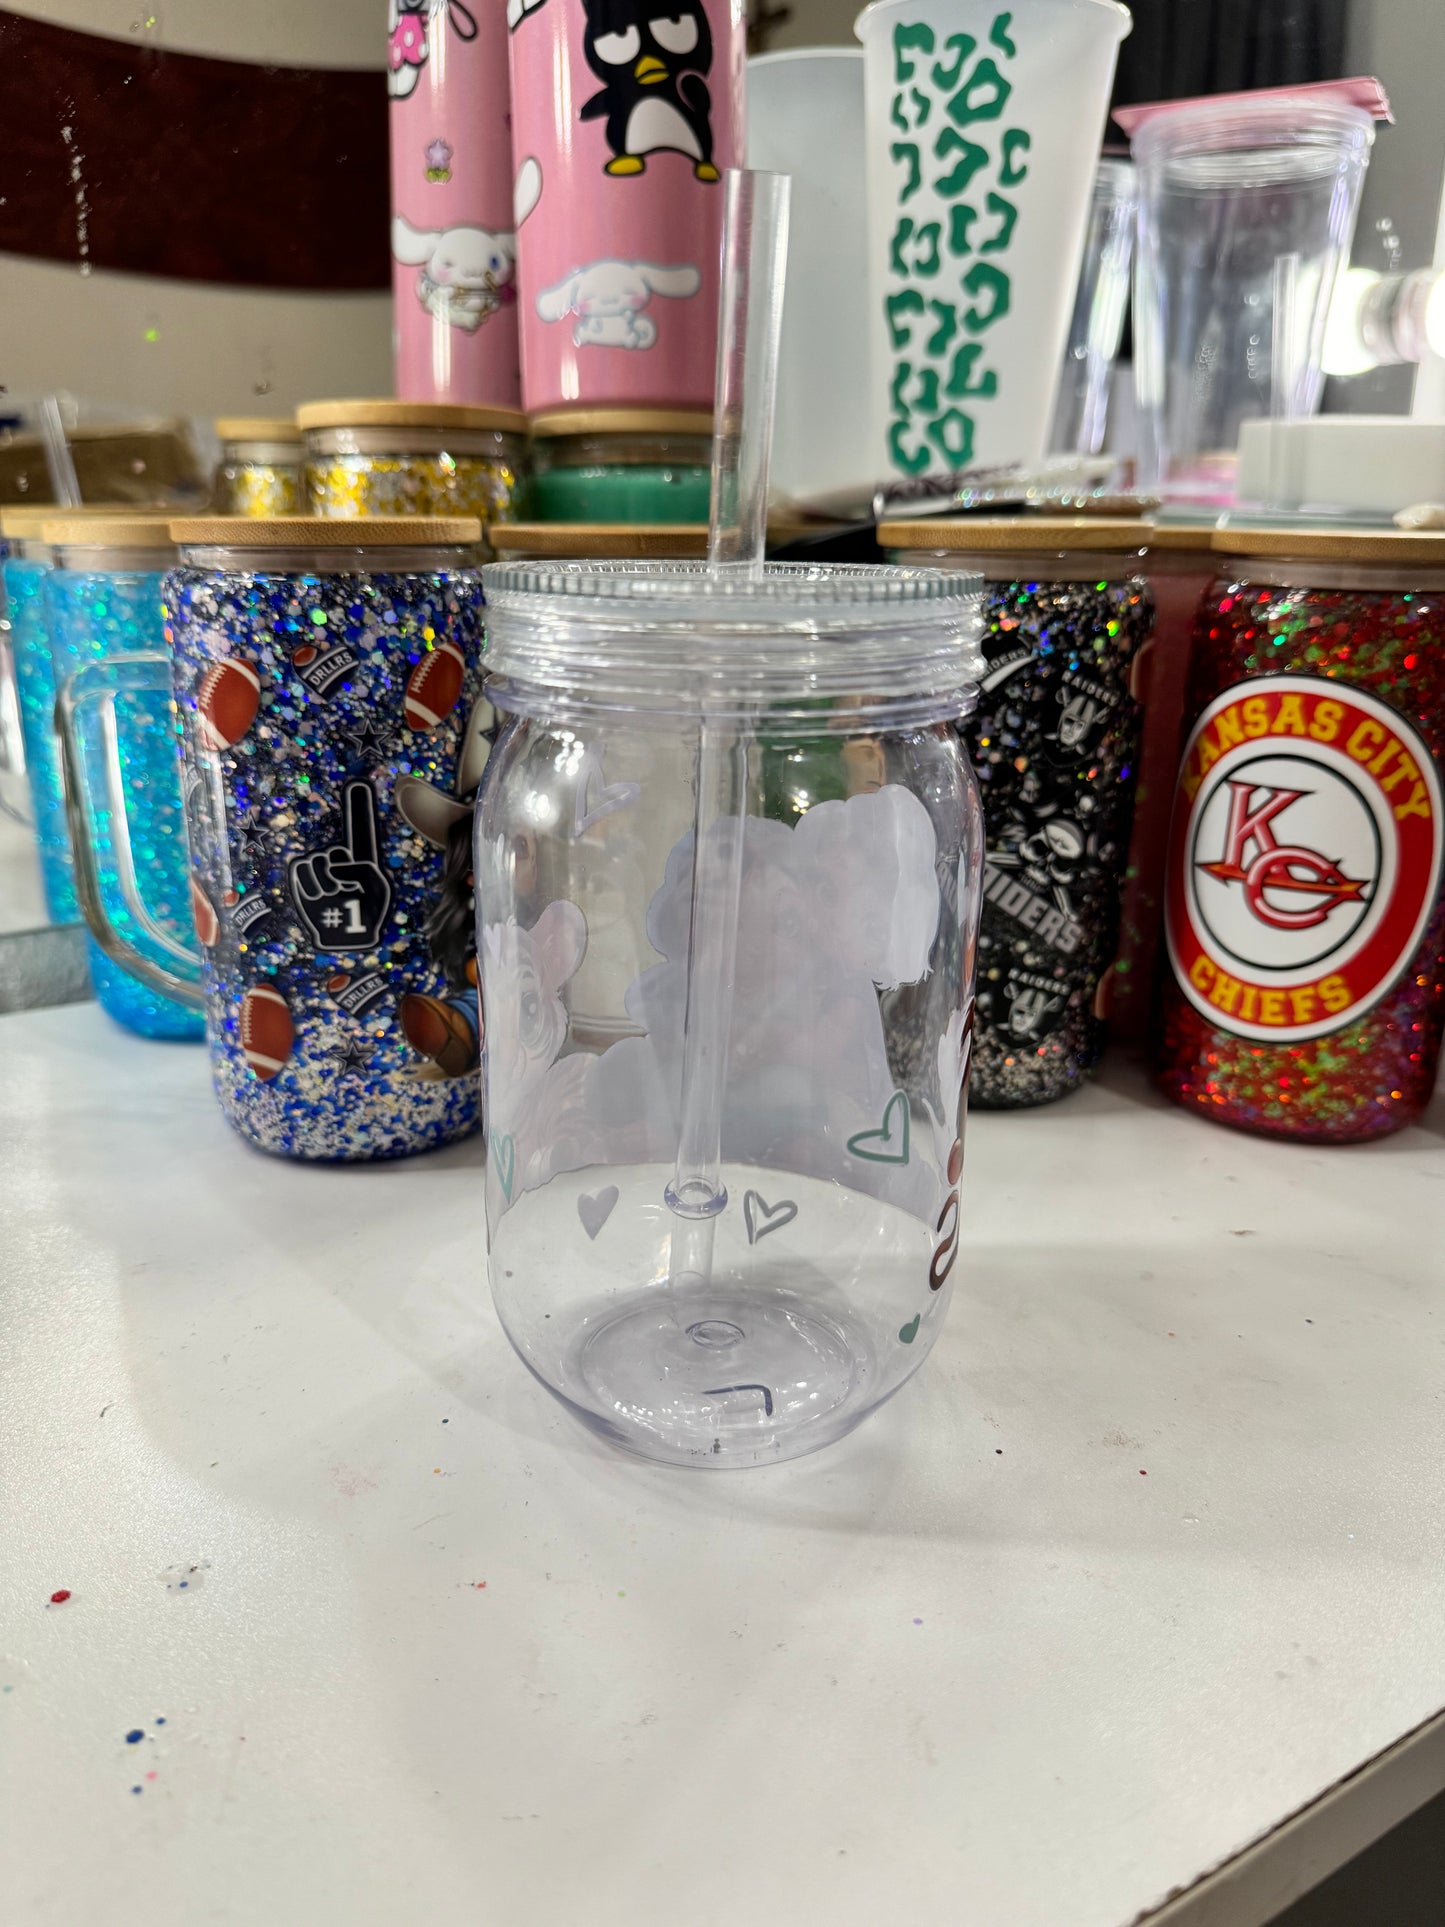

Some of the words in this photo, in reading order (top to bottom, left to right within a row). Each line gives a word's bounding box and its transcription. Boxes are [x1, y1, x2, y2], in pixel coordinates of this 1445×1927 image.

[310, 651, 353, 686] DRLLRS
[1180, 694, 1345, 803] KANSAS
[1346, 719, 1433, 821] CITY
[321, 900, 367, 934] #1
[1189, 953, 1353, 1026] CHIEFS
